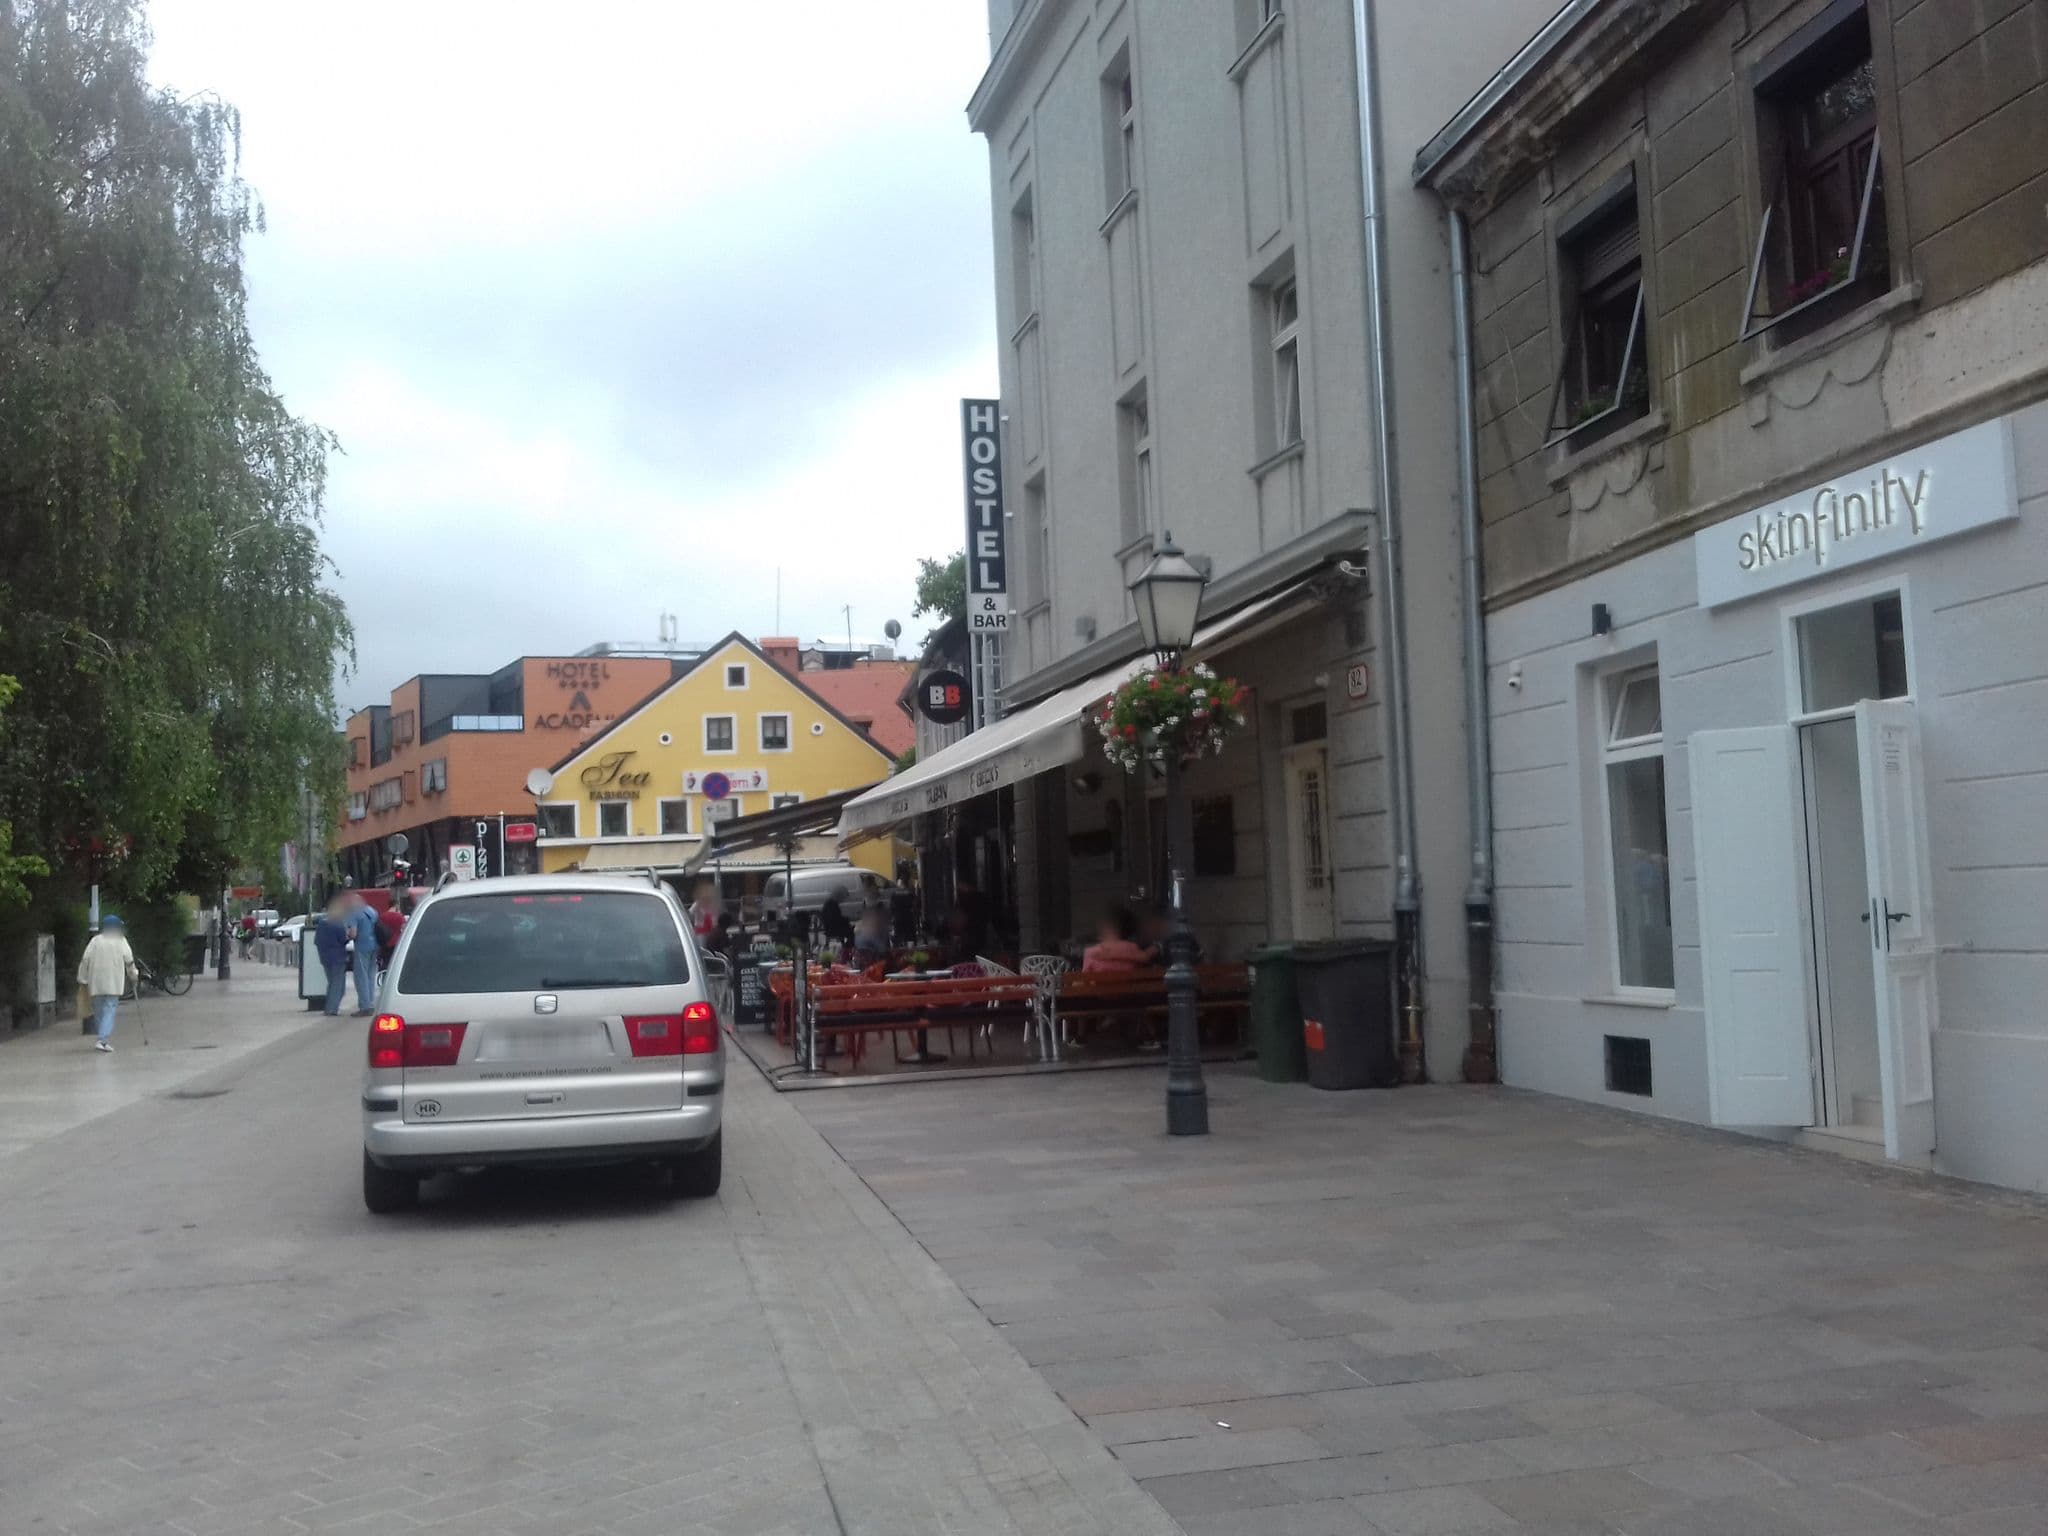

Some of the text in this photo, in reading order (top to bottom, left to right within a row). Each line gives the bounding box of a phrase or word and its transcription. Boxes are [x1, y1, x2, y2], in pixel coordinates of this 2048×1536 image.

[970, 405, 1000, 589] HOSTEL
[1738, 468, 1926, 570] skinfinity
[984, 597, 996, 611] &
[974, 614, 1007, 628] BAR
[547, 662, 610, 679] HOTEL
[929, 685, 961, 706] BB
[580, 750, 650, 786] Tea
[589, 791, 640, 801] FASHION
[420, 1104, 437, 1113] HR
